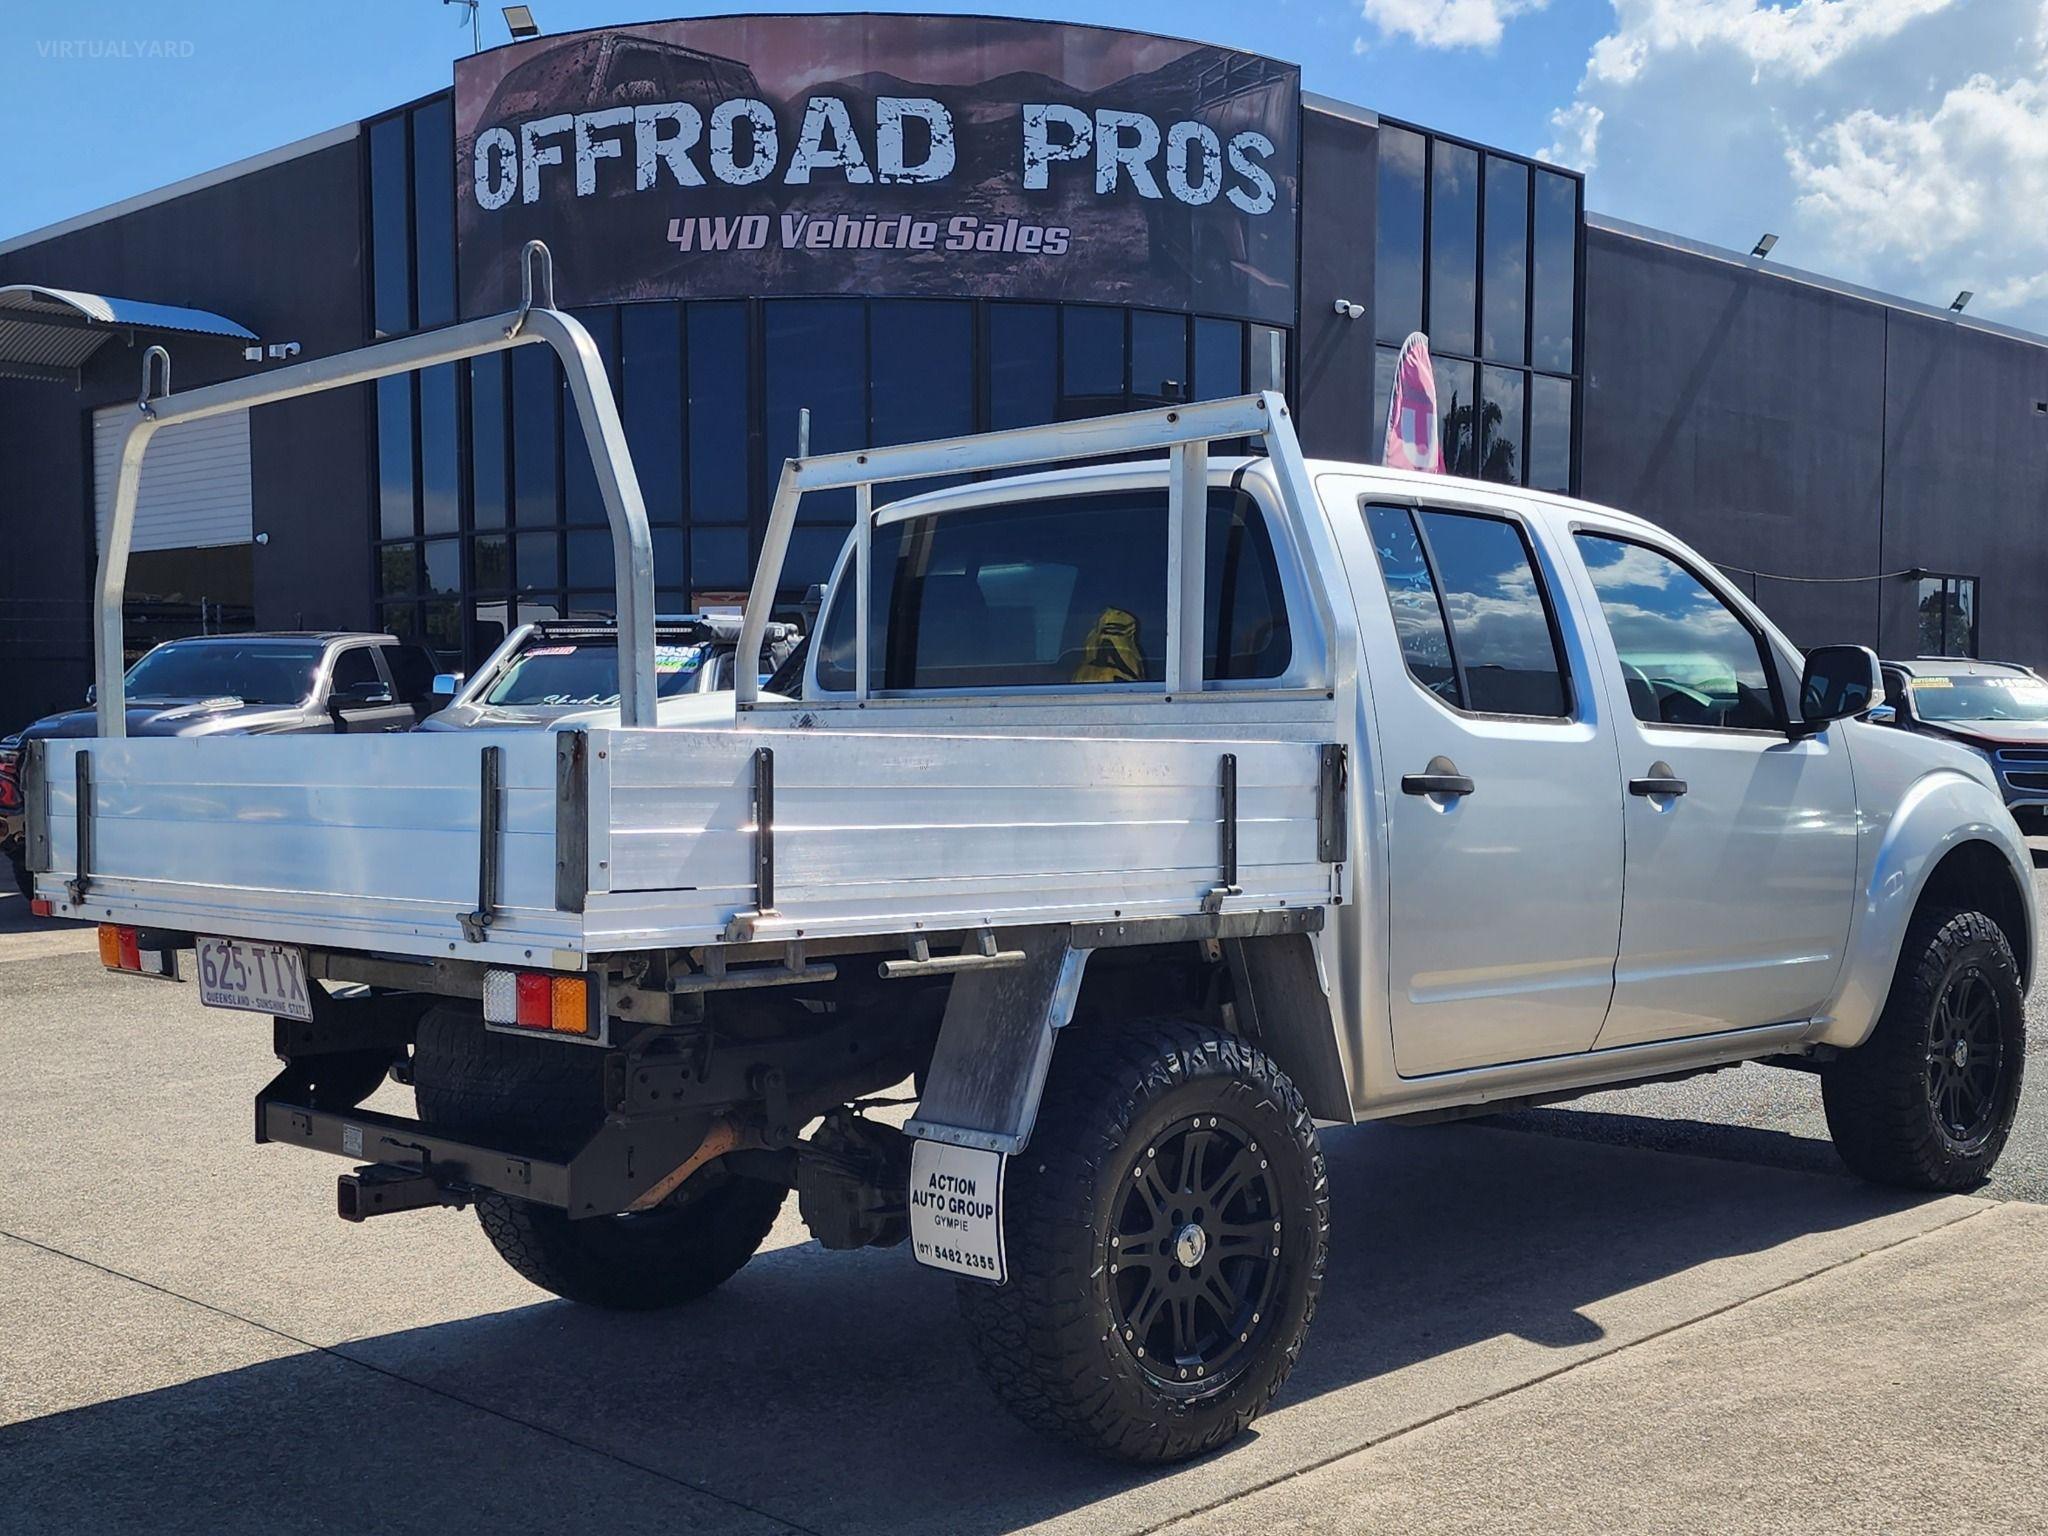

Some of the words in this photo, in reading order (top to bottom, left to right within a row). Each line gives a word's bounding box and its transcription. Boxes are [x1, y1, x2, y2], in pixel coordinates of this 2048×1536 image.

[473, 96, 958, 211] OFFROAD
[1022, 103, 1277, 216] PROS
[666, 214, 770, 252] 4WD
[779, 213, 938, 251] Vehicle
[945, 215, 1071, 256] Sales
[206, 991, 250, 1007] QUEENSLAND
[255, 998, 286, 1013] SUNSHINE
[288, 1003, 306, 1017] STATE
[929, 1172, 976, 1197] ACTION
[912, 1189, 945, 1211] AUTO
[948, 1197, 993, 1220] GROUP
[934, 1214, 968, 1232] GYMPIE
[916, 1240, 933, 1257] (07)
[935, 1245, 963, 1265] 5482
[965, 1252, 995, 1271] 2355
